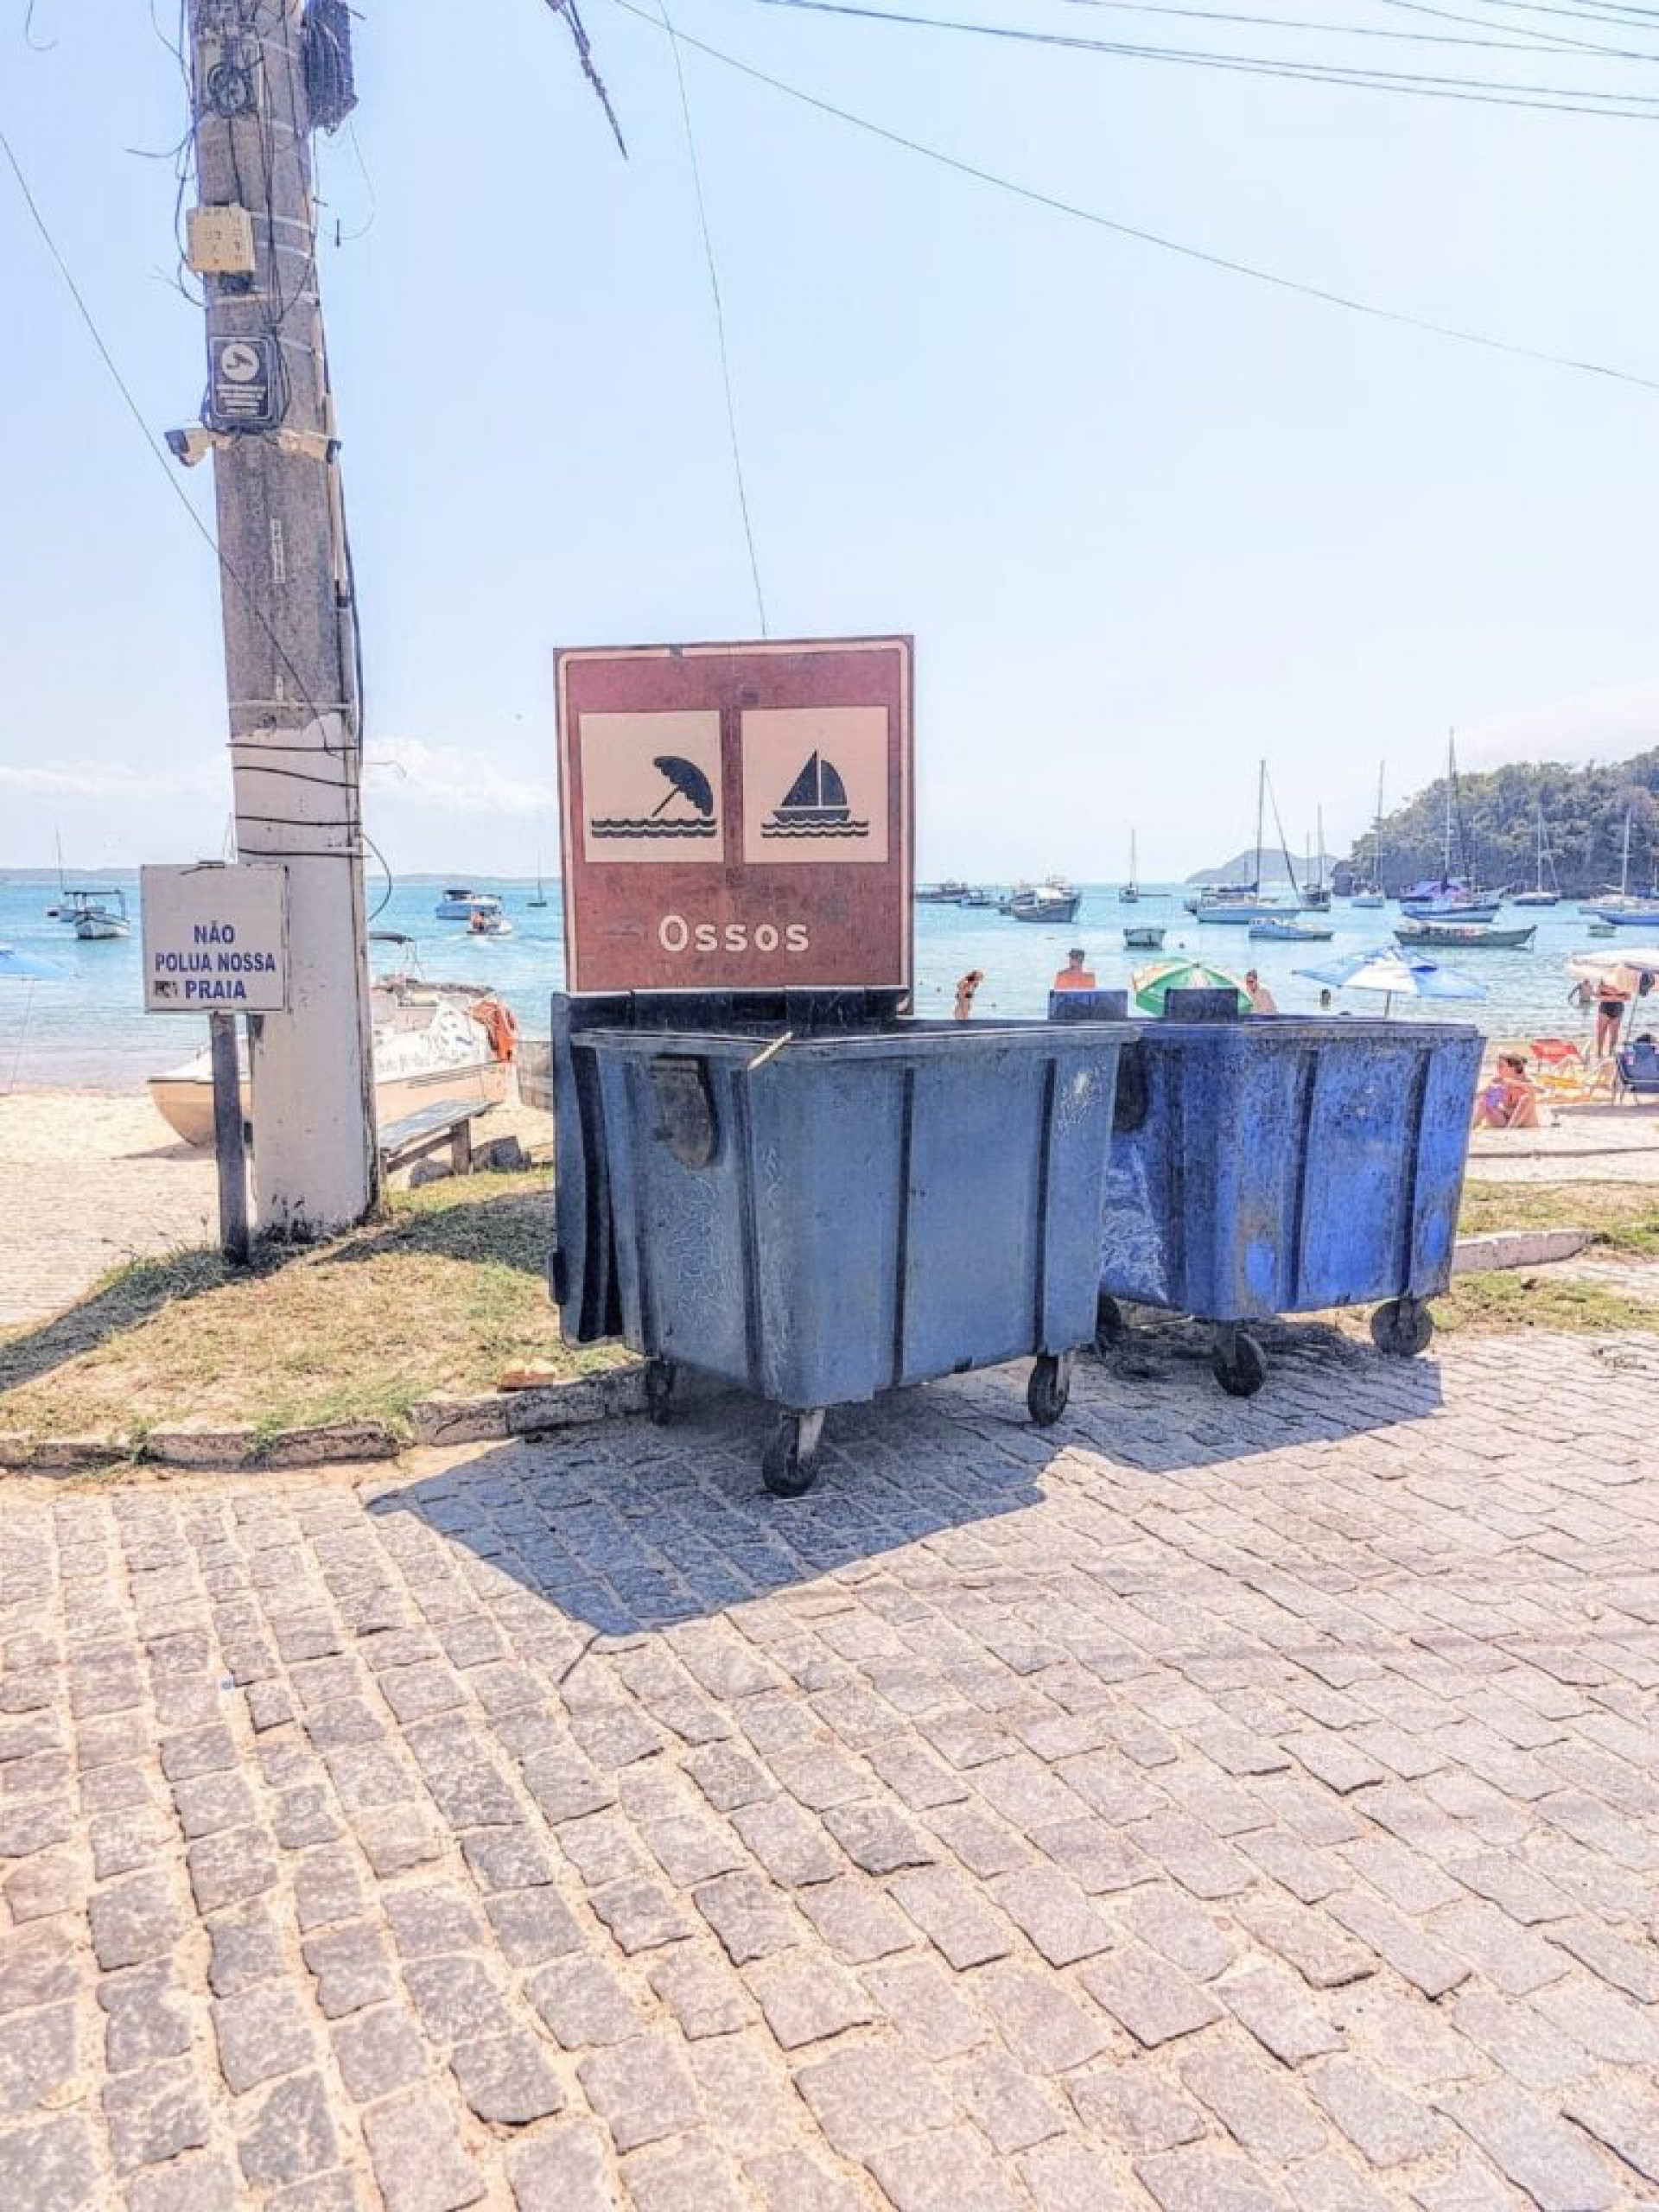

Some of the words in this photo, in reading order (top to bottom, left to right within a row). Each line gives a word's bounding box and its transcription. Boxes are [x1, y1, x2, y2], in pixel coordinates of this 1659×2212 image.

[194, 920, 236, 944] NÃO
[659, 915, 809, 951] Ossos
[155, 952, 213, 972] POLUA
[218, 952, 276, 972] NOSSA
[185, 980, 247, 999] PRAIA
